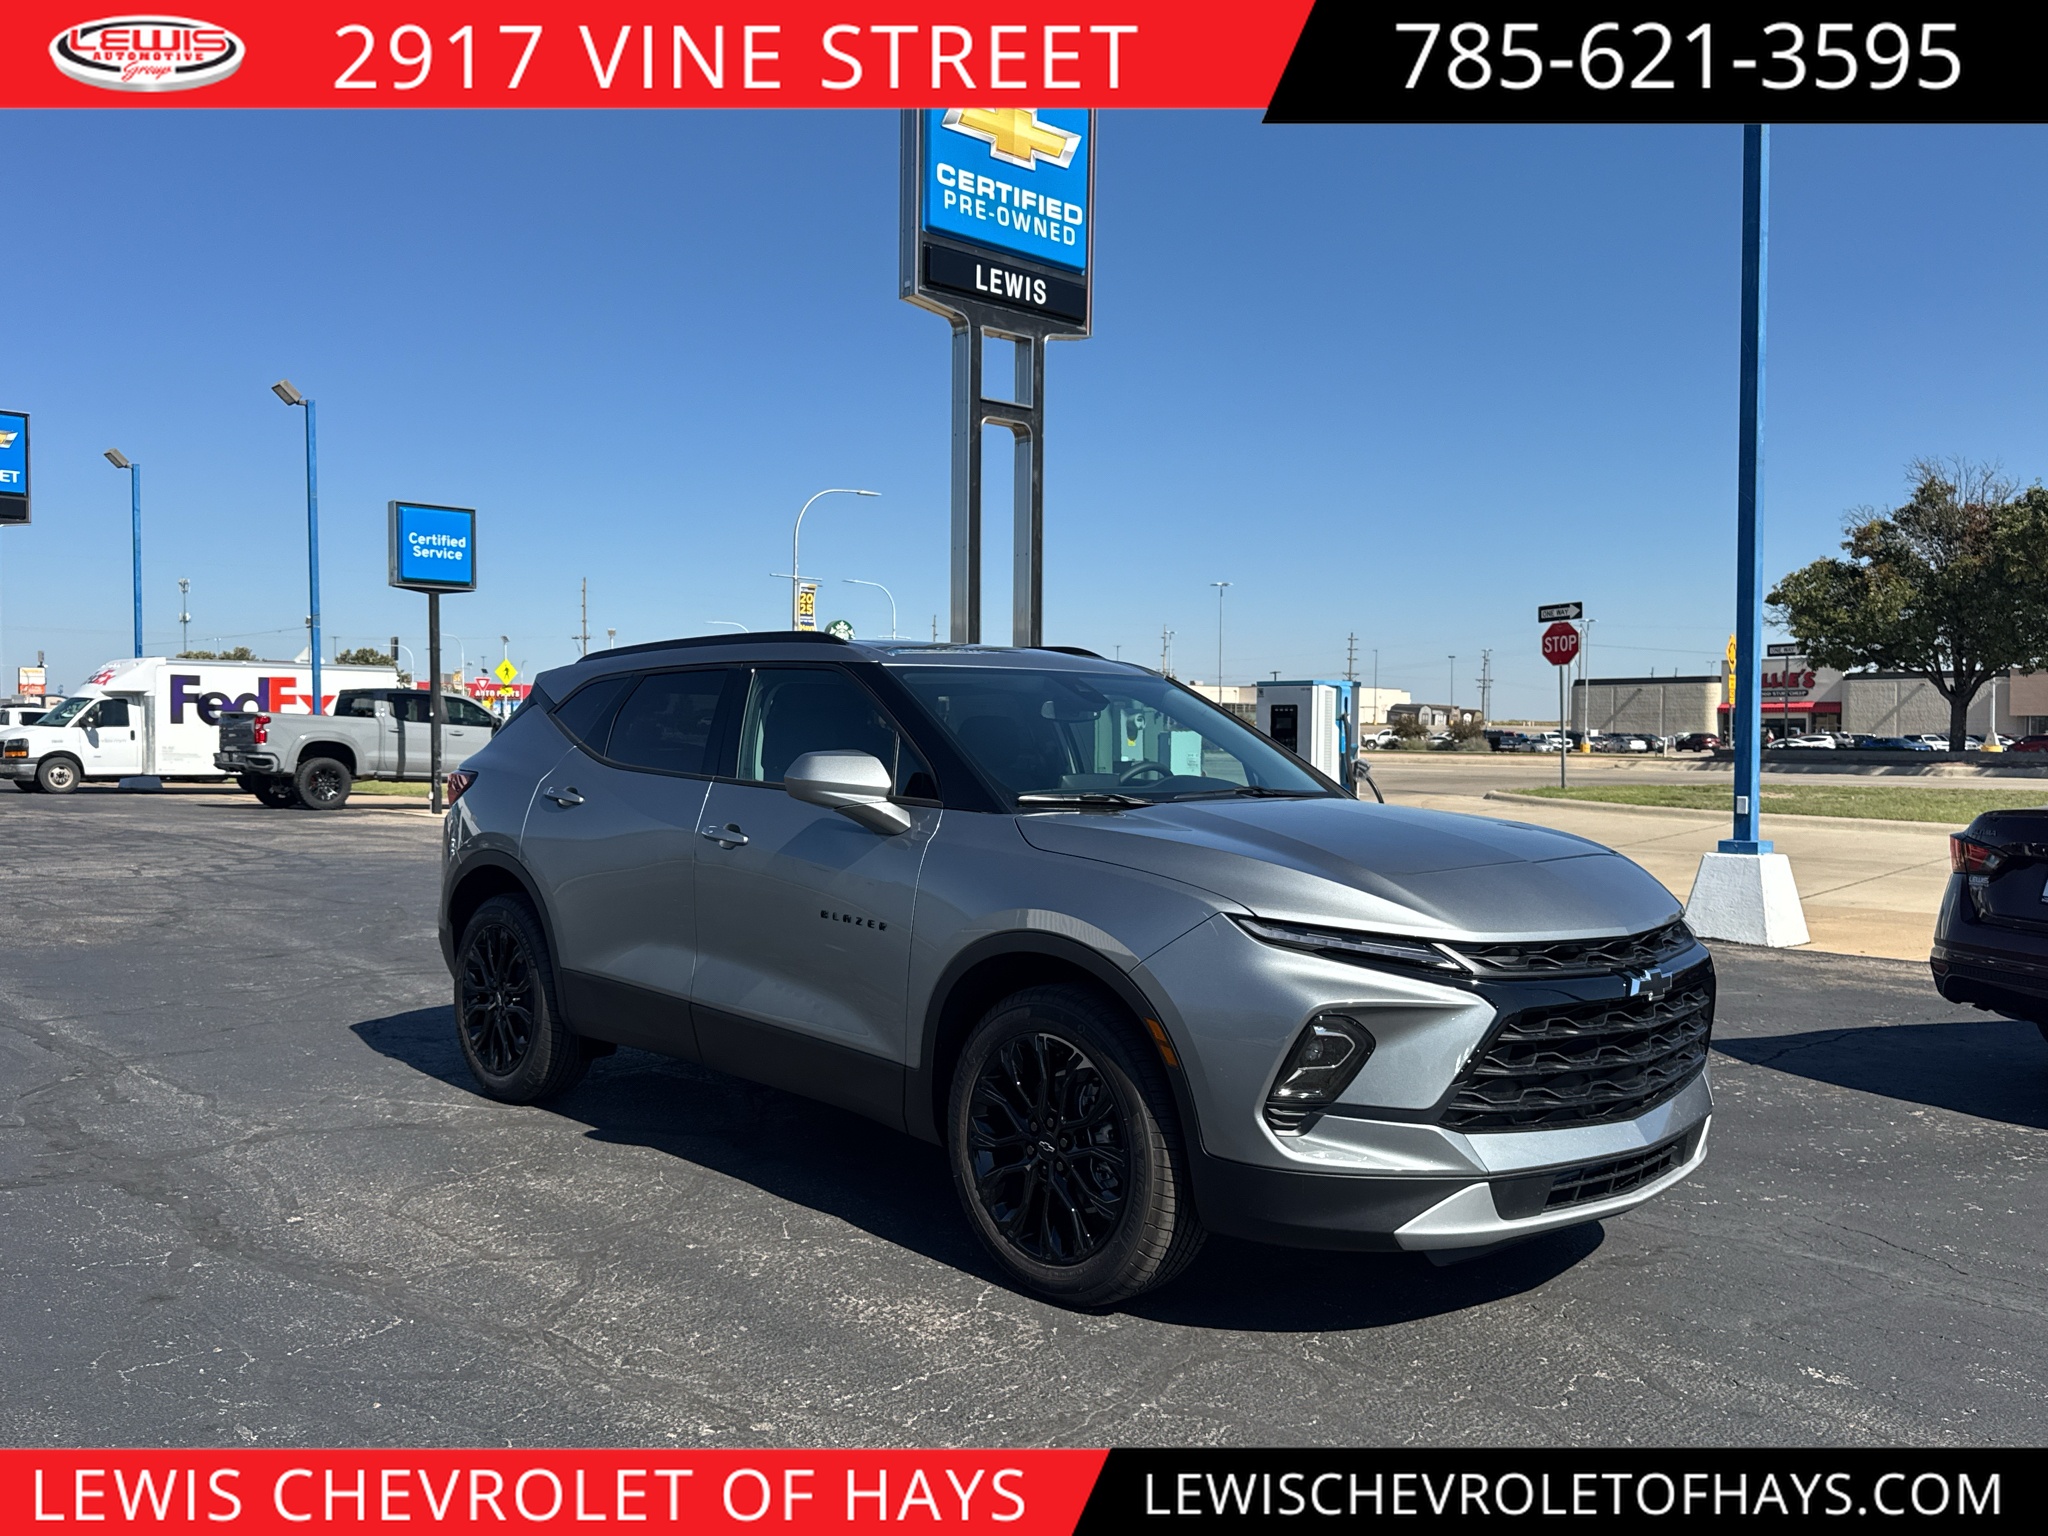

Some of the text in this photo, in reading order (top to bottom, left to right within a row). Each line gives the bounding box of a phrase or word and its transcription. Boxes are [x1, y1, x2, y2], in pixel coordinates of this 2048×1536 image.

[936, 162, 1083, 226] CERTIFIED
[944, 189, 1076, 246] PRE-OWNED
[975, 263, 1047, 305] LEWIS
[408, 531, 467, 548] Certified
[412, 545, 463, 561] Service
[800, 592, 814, 604] 20
[800, 603, 813, 615] 25
[1542, 608, 1569, 618] ONE WAY
[1544, 634, 1577, 653] STOP
[1762, 668, 1816, 689] LLIE'S
[820, 910, 887, 931] BLAZER
